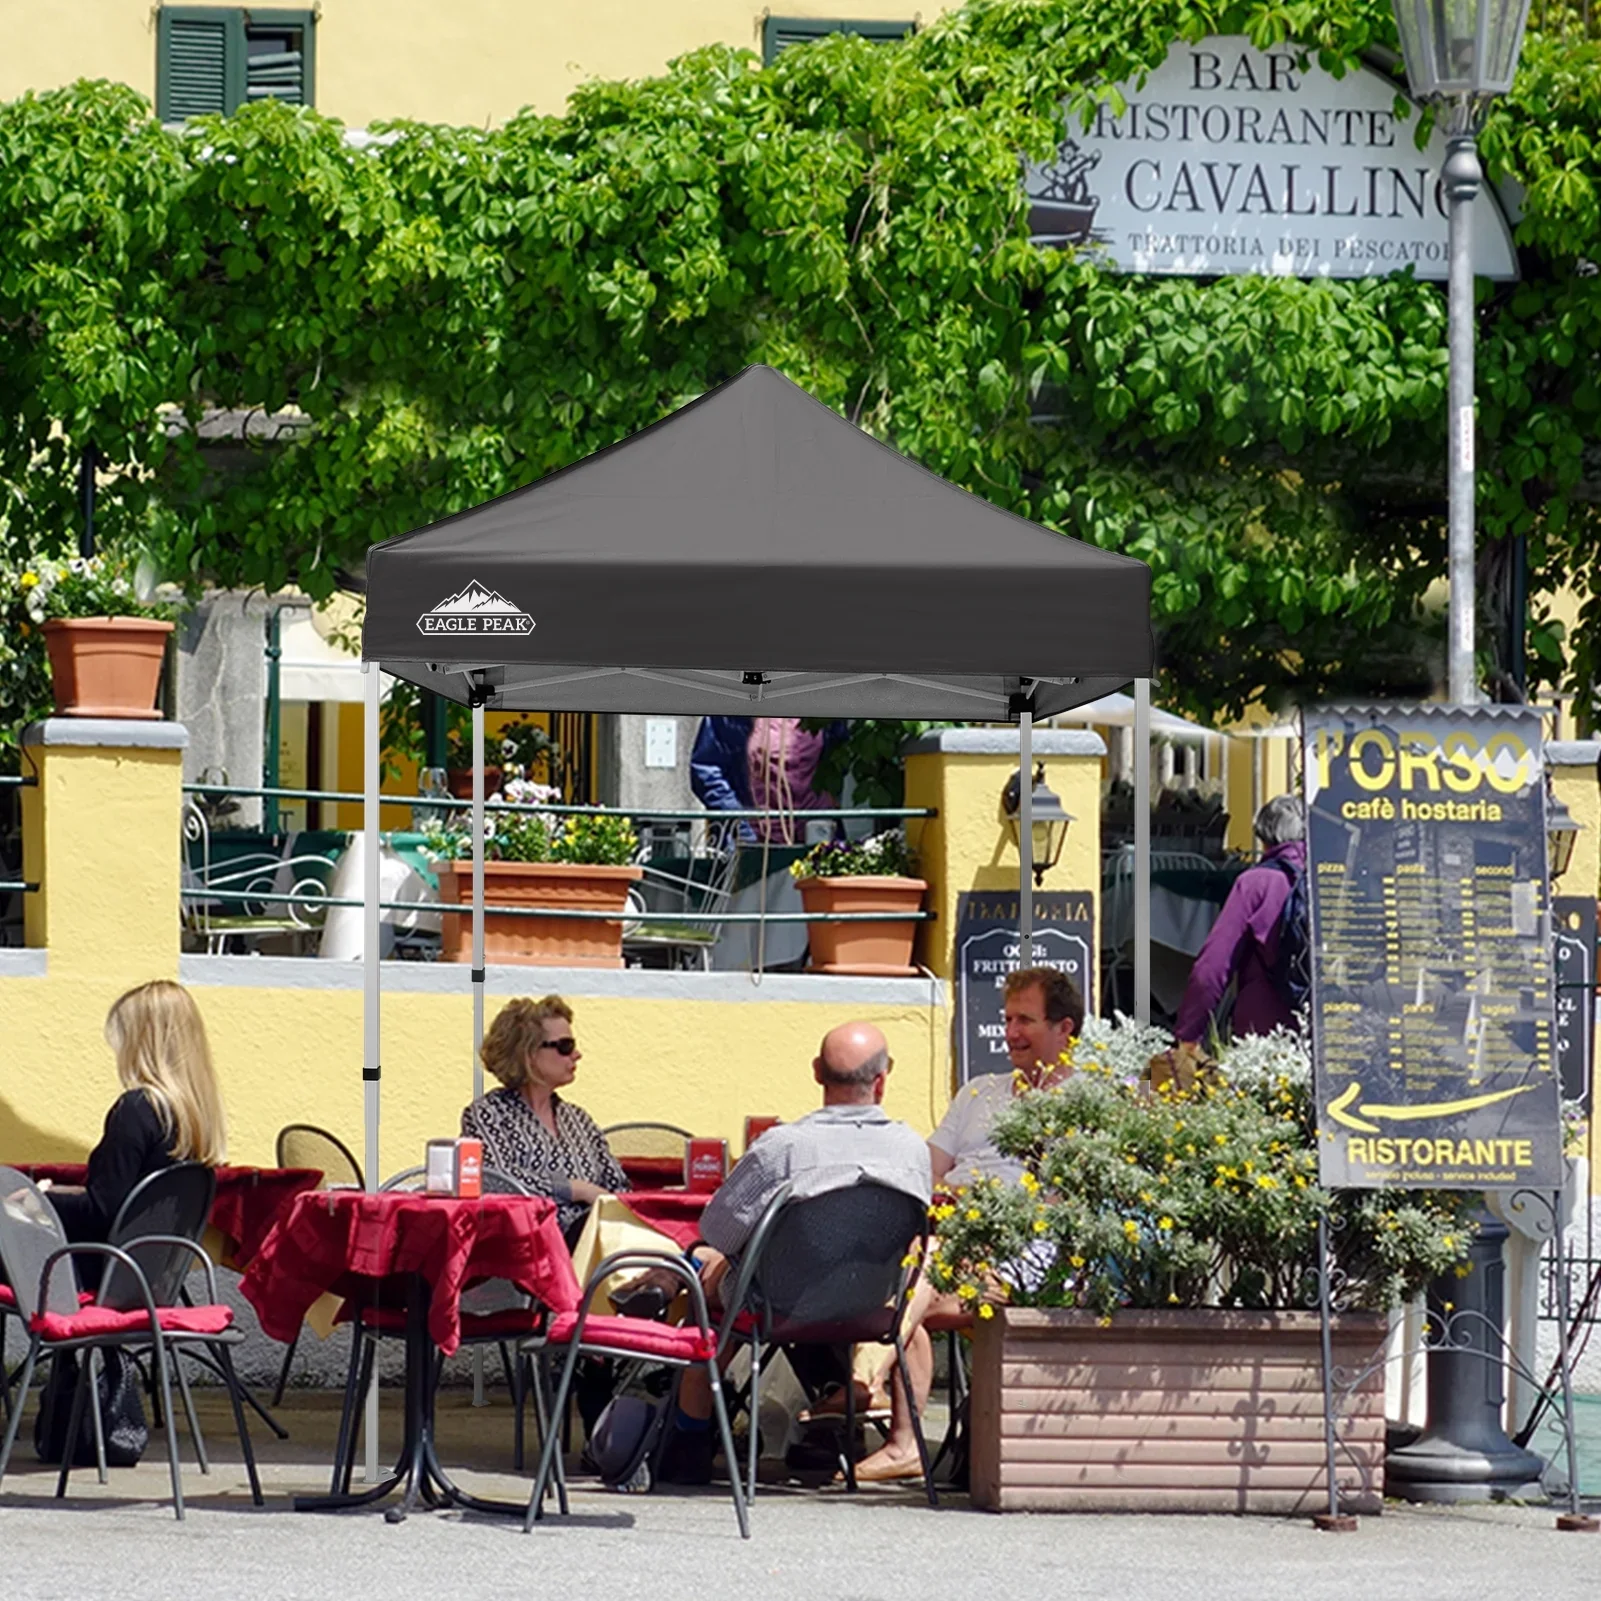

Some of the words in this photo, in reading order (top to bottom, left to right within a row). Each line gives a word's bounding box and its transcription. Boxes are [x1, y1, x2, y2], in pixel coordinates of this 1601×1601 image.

[1189, 51, 1300, 92] BAR
[1092, 101, 1396, 148] RISTORANTE
[1127, 233, 1264, 256] TRATTORIA
[1278, 237, 1321, 258] DEI
[1333, 239, 1449, 262] PESCATO
[424, 618, 477, 631] EAGLE
[1401, 798, 1502, 821] hostaria
[1347, 1137, 1533, 1166] RISTORANTE
